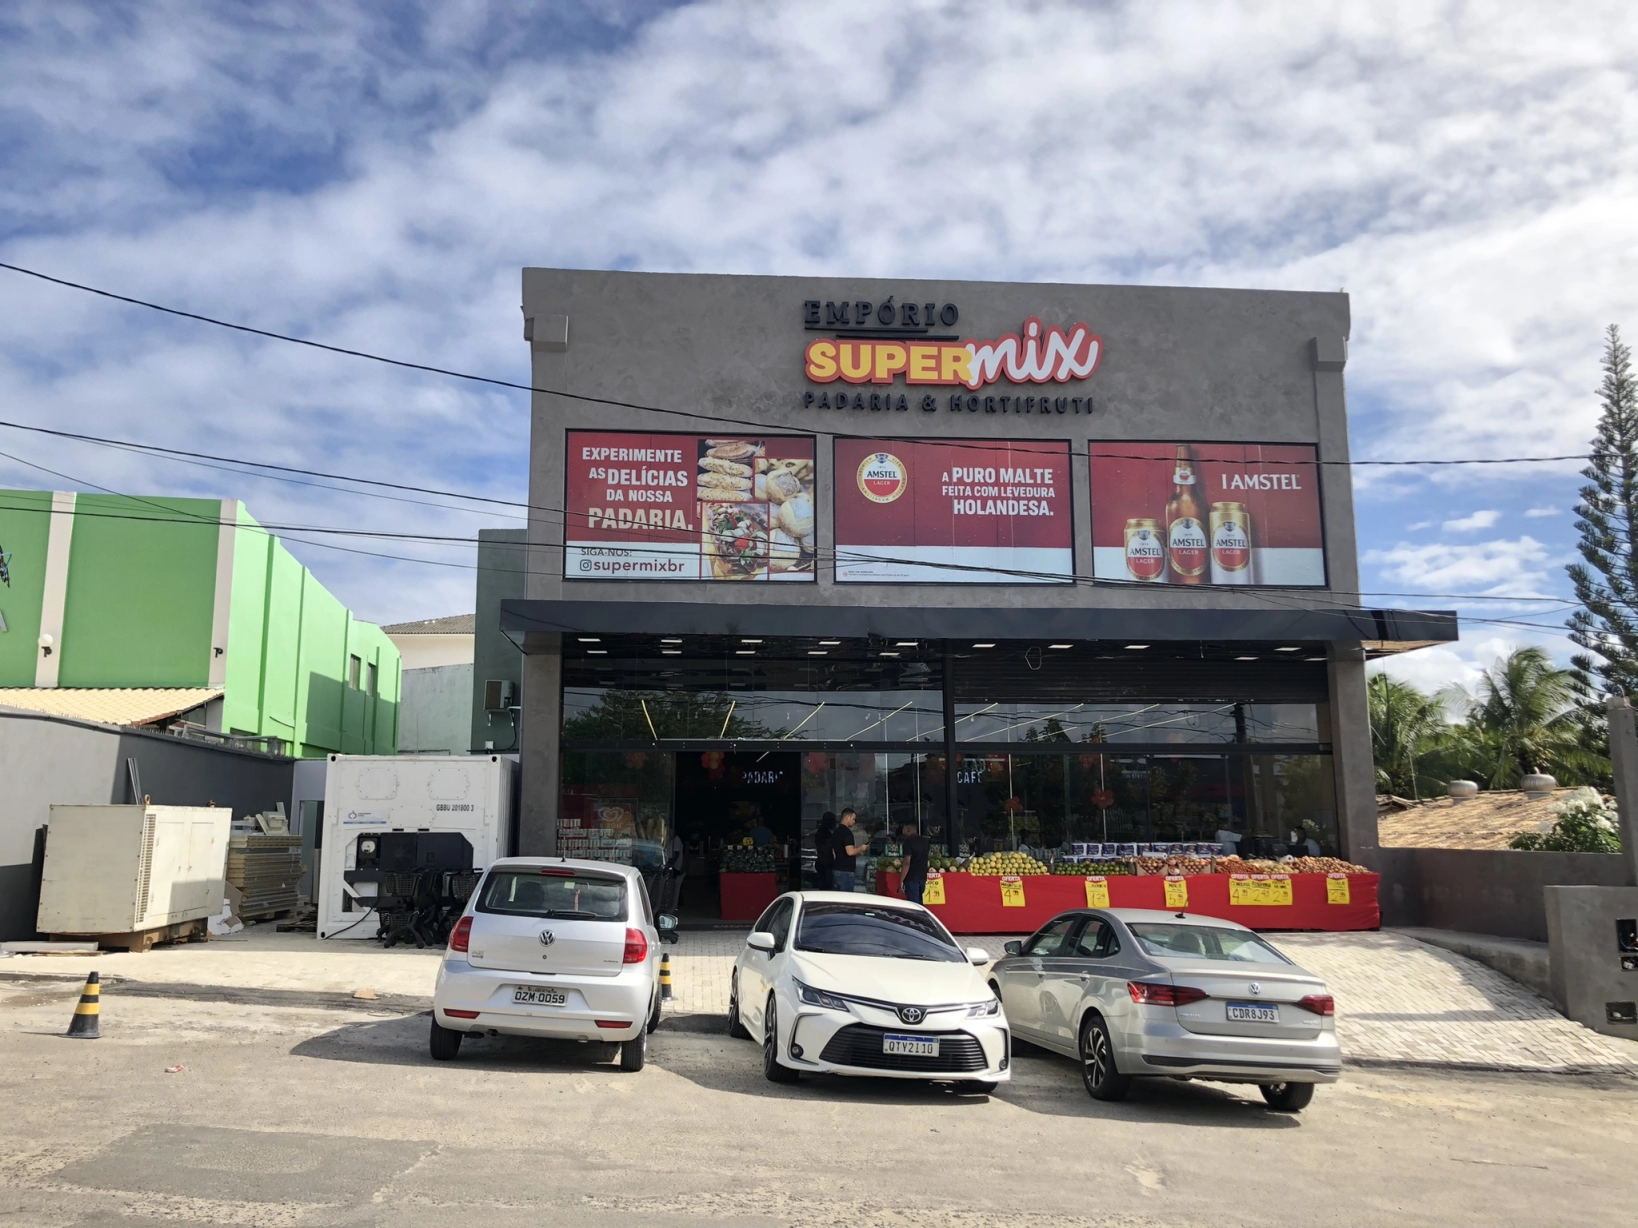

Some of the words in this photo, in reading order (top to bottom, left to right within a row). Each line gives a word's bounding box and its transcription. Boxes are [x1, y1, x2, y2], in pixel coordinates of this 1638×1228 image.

[804, 296, 960, 326] EMPÓRIO
[804, 391, 909, 412] PADARIA
[922, 394, 937, 412] &
[950, 394, 1094, 415] HORTIFRUTI
[582, 447, 682, 463] EXPERIMENTE
[589, 467, 606, 479] AS
[607, 465, 688, 487] DELÍCIAS
[866, 470, 898, 479] AMSTEL
[942, 472, 949, 482] A
[952, 467, 996, 483] PURO
[1000, 467, 1053, 484] MALTE
[1231, 474, 1302, 490] AMSTEL
[606, 489, 624, 502] DA
[628, 489, 673, 503] NOSSA
[942, 485, 972, 496] FEITA
[974, 486, 998, 497] COM
[1001, 486, 1055, 498] LEVEDURA
[953, 499, 1054, 516] HOLANDESA.
[588, 507, 694, 530] PADARIA.
[1172, 538, 1205, 547] AMSTEL
[1215, 538, 1246, 548] AMSTEL
[1129, 548, 1161, 556] AMSTEL
[593, 558, 685, 577] supermixbr
[1232, 1008, 1275, 1020] CDR8J93
[888, 1041, 934, 1055] QTY2I10
